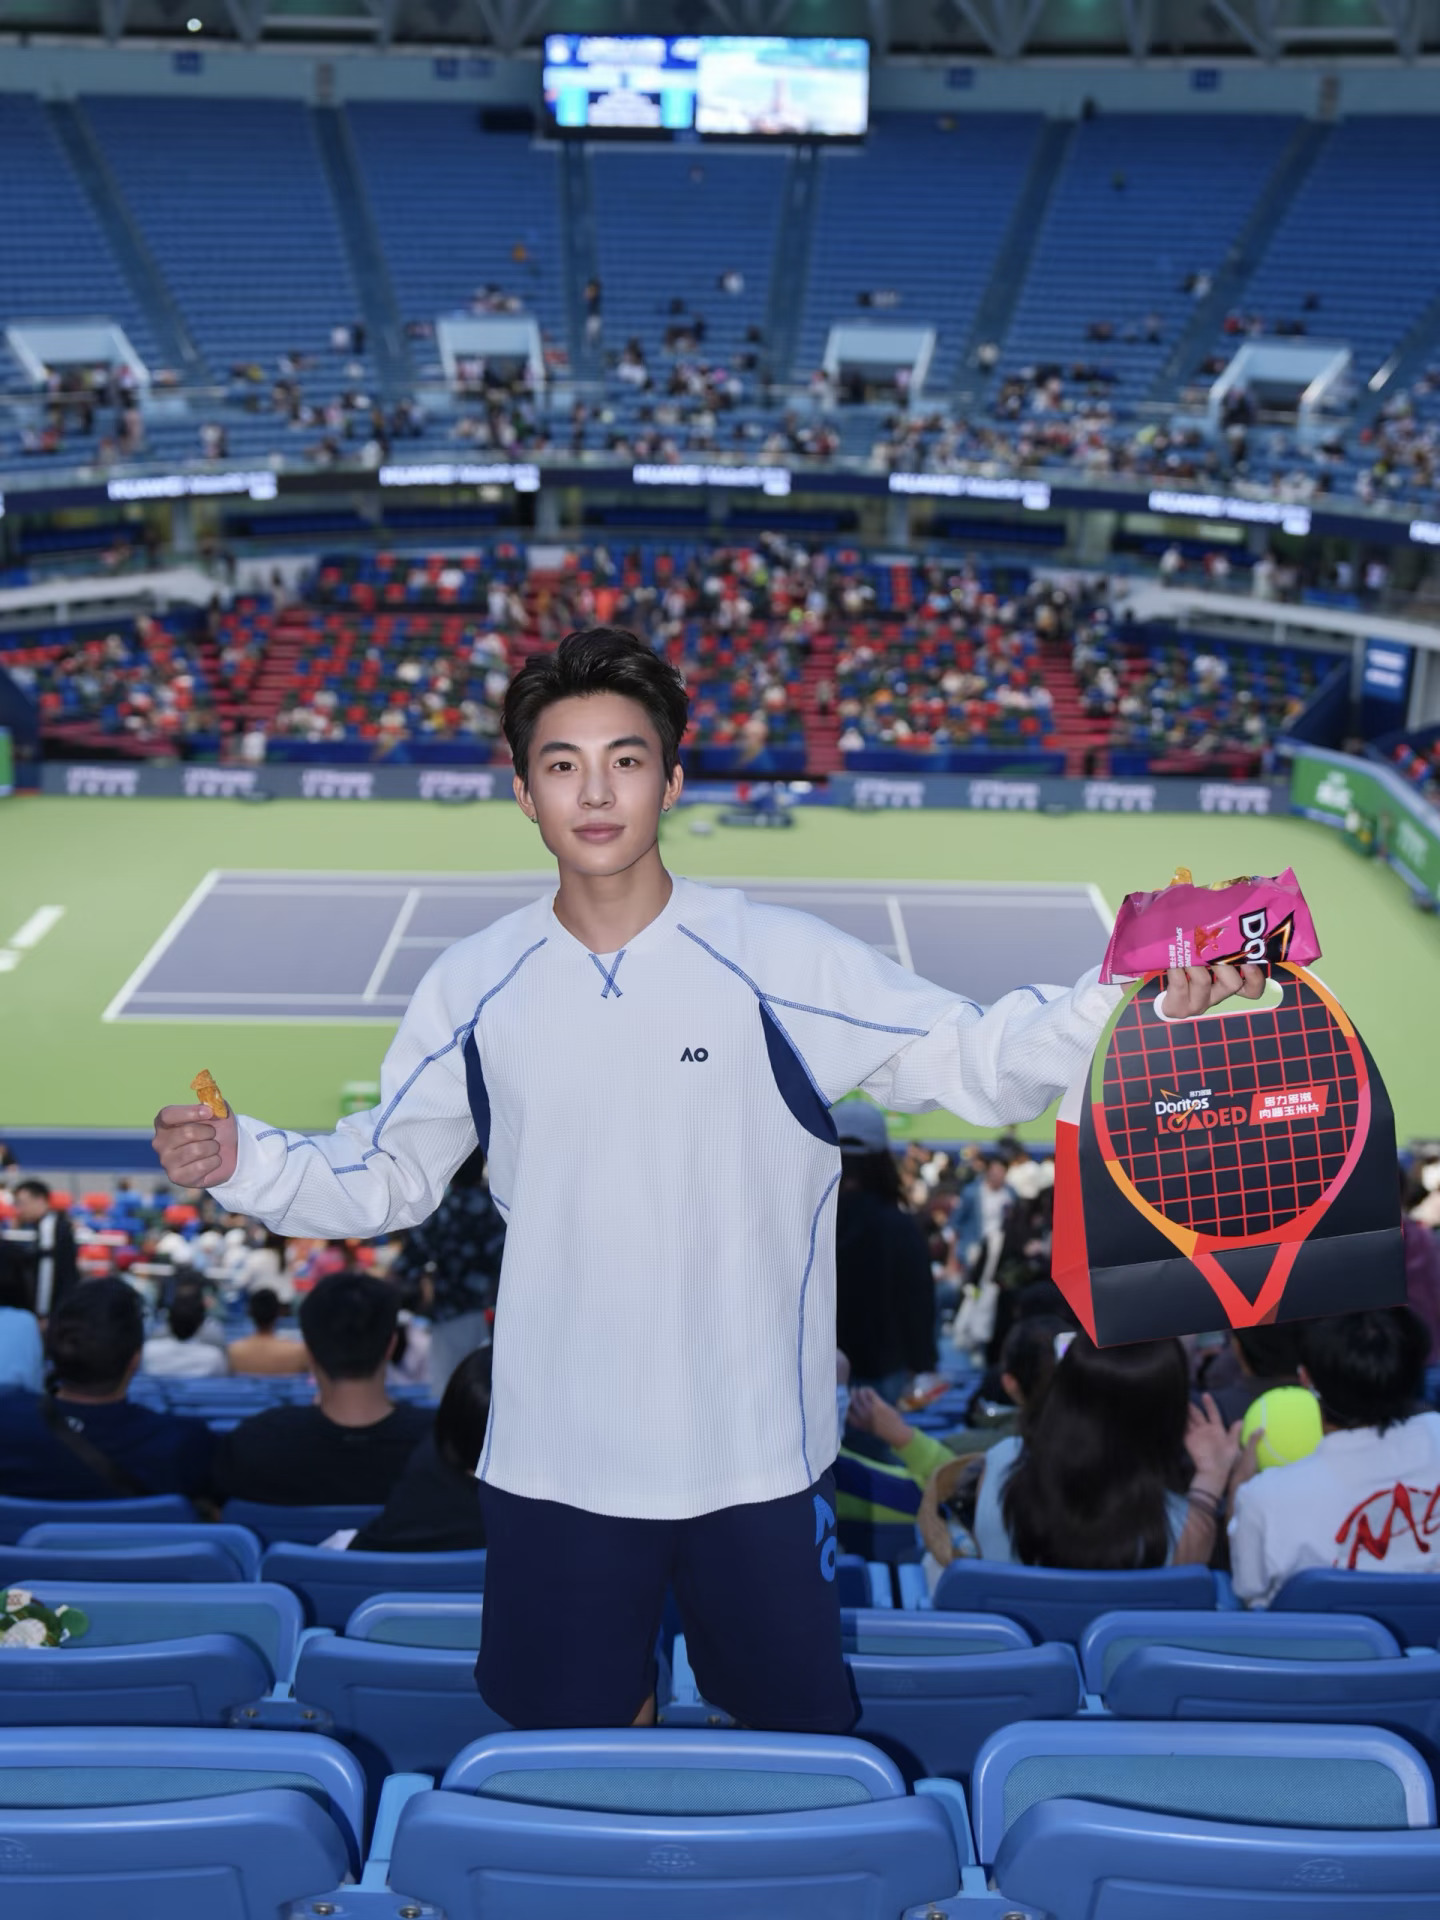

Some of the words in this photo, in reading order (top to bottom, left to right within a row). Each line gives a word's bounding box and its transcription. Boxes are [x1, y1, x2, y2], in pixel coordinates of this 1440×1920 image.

[1175, 927, 1183, 947] SPICY
[1240, 909, 1268, 964] Do
[680, 1047, 709, 1062] AO
[1155, 1098, 1209, 1115] Doritos
